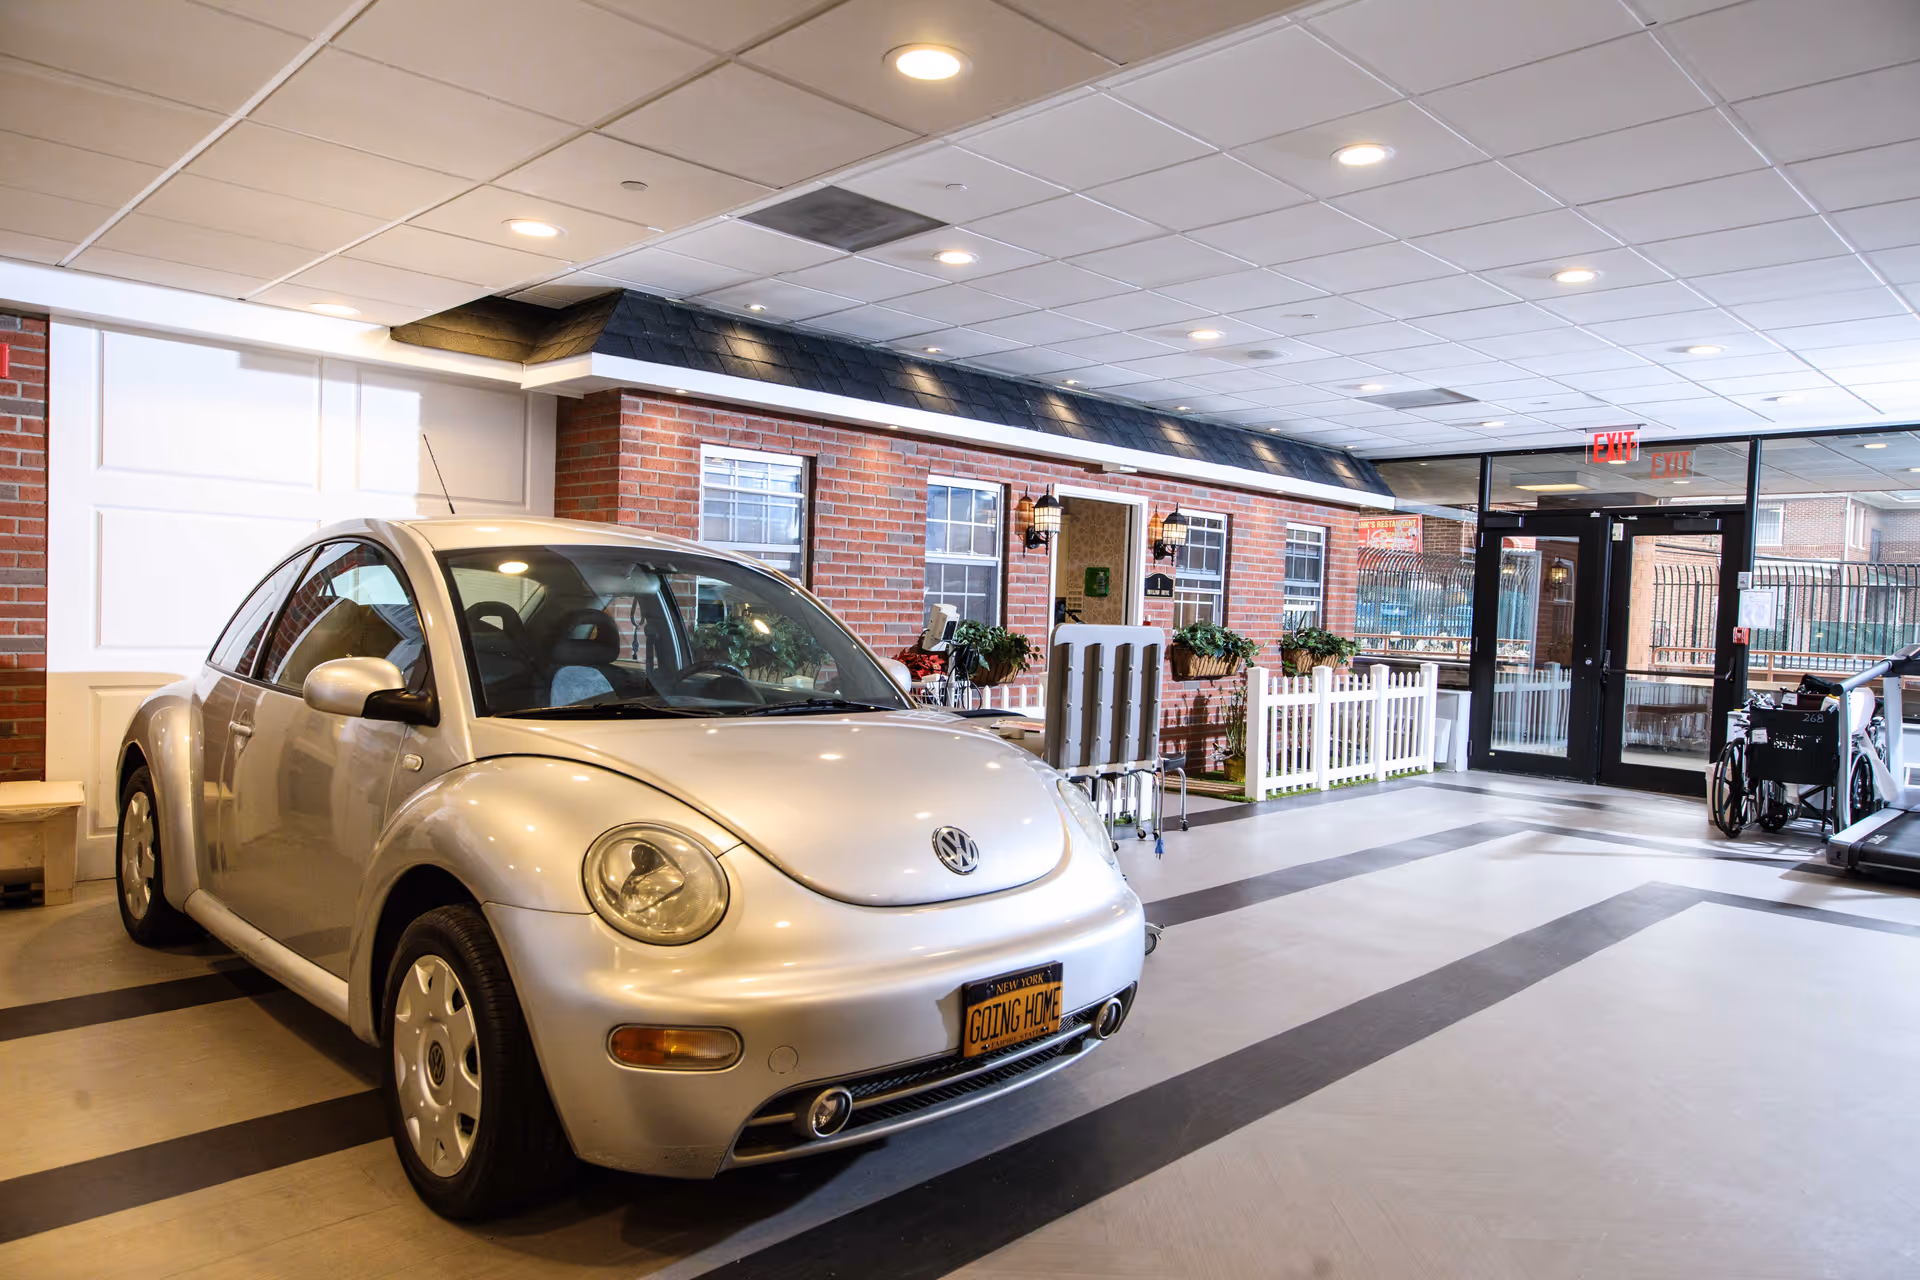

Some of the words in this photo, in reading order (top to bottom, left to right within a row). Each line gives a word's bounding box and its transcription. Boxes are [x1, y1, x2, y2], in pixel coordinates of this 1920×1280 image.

[1593, 431, 1635, 463] EXIT
[1651, 451, 1691, 480] EXIT
[1802, 713, 1824, 723] 268
[996, 979, 1019, 995] NEW
[1021, 972, 1045, 988] YORK
[970, 998, 1021, 1044] GOING
[1024, 986, 1061, 1029] HOME
